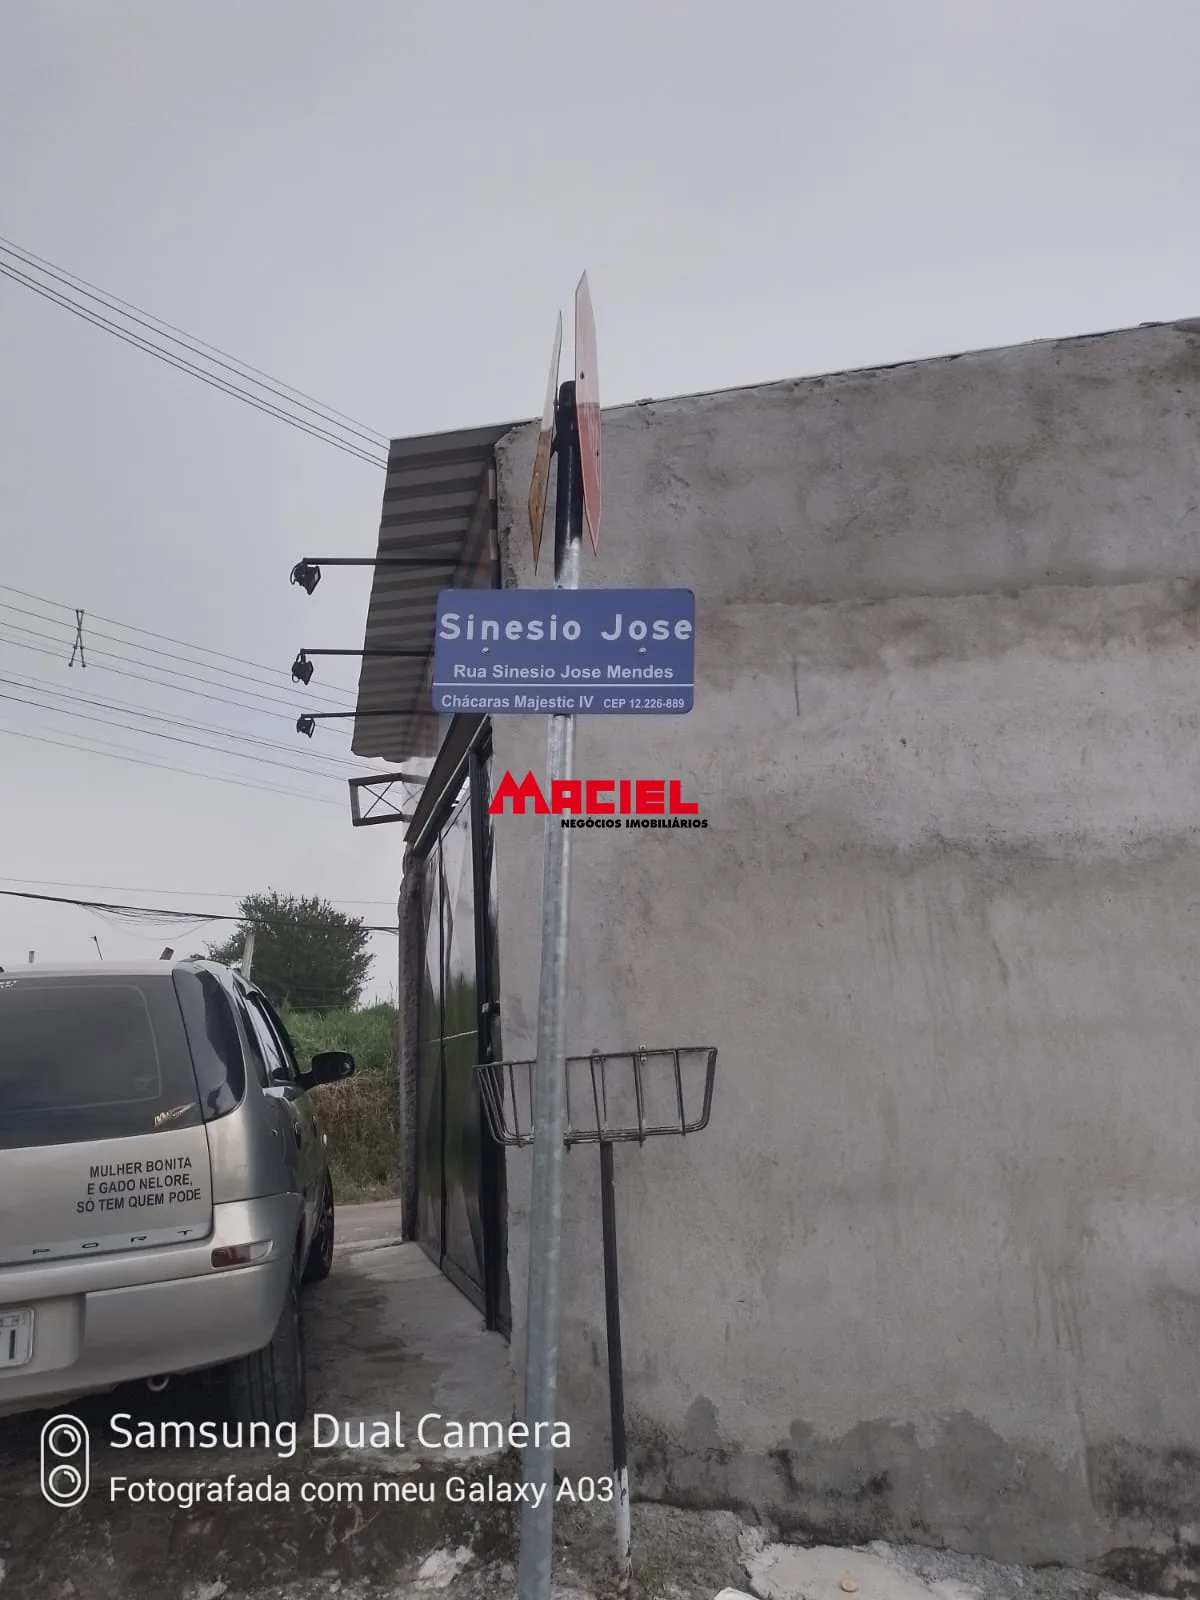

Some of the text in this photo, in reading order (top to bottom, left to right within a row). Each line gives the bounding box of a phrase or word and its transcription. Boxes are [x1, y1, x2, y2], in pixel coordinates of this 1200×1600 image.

[439, 613, 692, 641] Sinesio Jose
[454, 664, 674, 678] Rua Sinesio Jose Mendes
[441, 694, 510, 708] Chácaras
[514, 695, 574, 710] Majestic
[579, 695, 594, 708] IV
[603, 698, 626, 708] CEP
[90, 1157, 192, 1178] MULHER BONITA
[88, 1183, 95, 1194] E
[99, 1180, 136, 1194] GADO
[77, 1188, 200, 1213] SÓ TEM QUEM PODE
